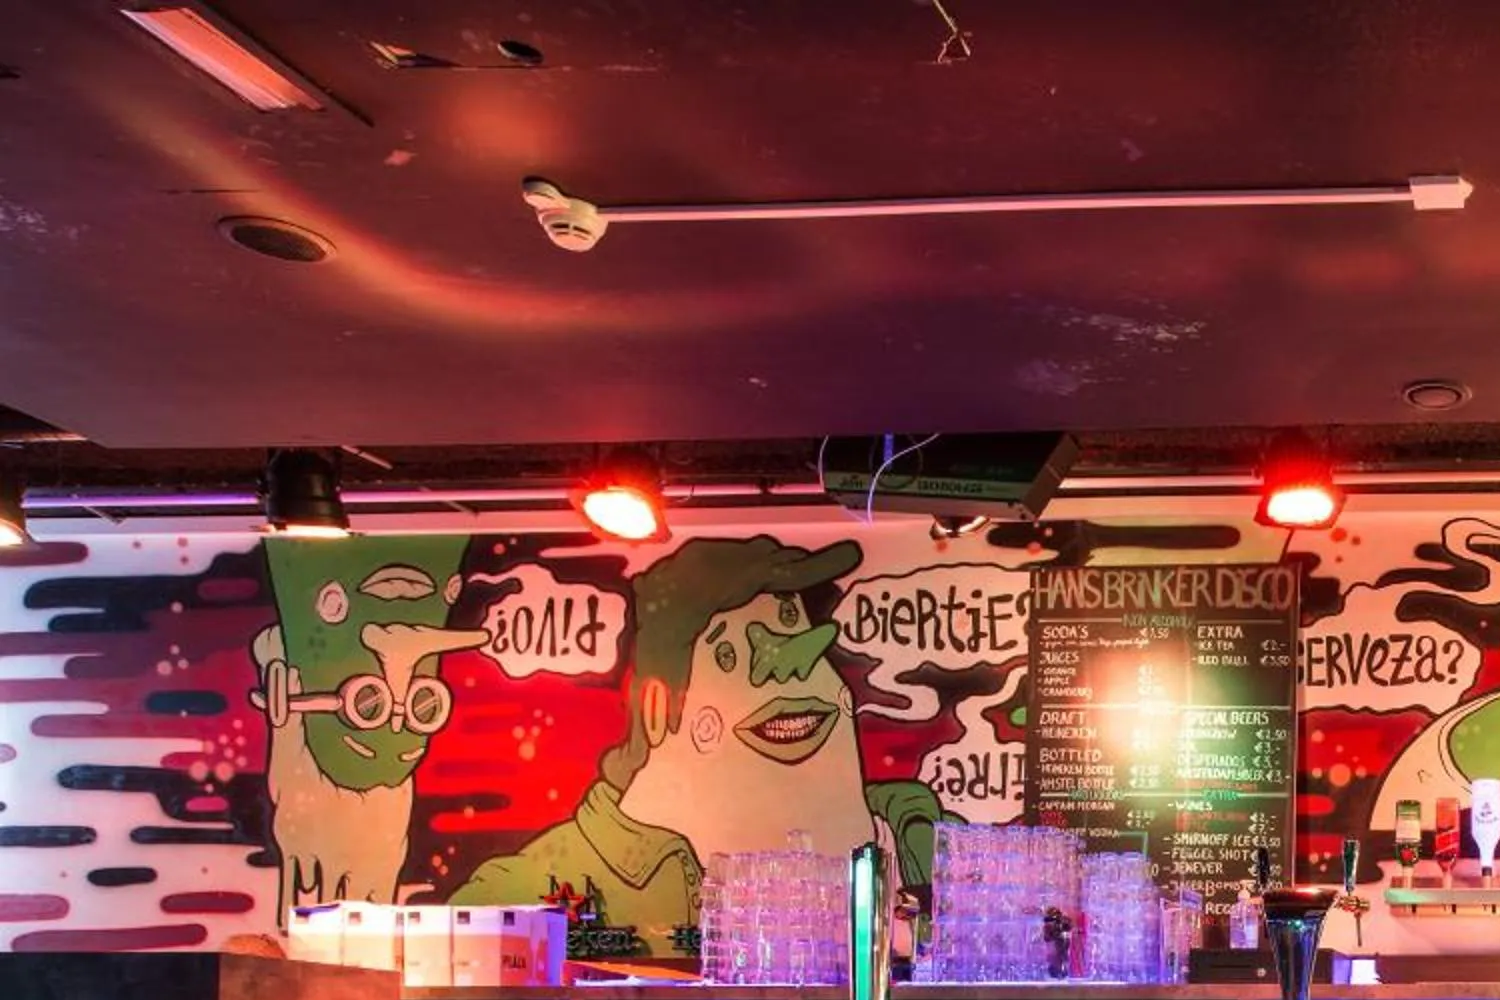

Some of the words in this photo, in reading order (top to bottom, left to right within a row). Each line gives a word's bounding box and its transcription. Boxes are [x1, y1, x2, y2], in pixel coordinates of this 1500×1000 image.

[1034, 569, 1101, 609] HANS
[1103, 568, 1214, 609] BRINKER
[1216, 568, 1295, 610] DISCO
[1197, 625, 1245, 639] EXTRA
[1298, 633, 1465, 689] ERVeza?
[1040, 710, 1087, 725] DRAFT
[1039, 747, 1102, 763] BOTTLED
[1173, 833, 1230, 846] SMIRNOFF
[1219, 849, 1250, 861] SHOT
[1169, 861, 1225, 875] JENEVER
